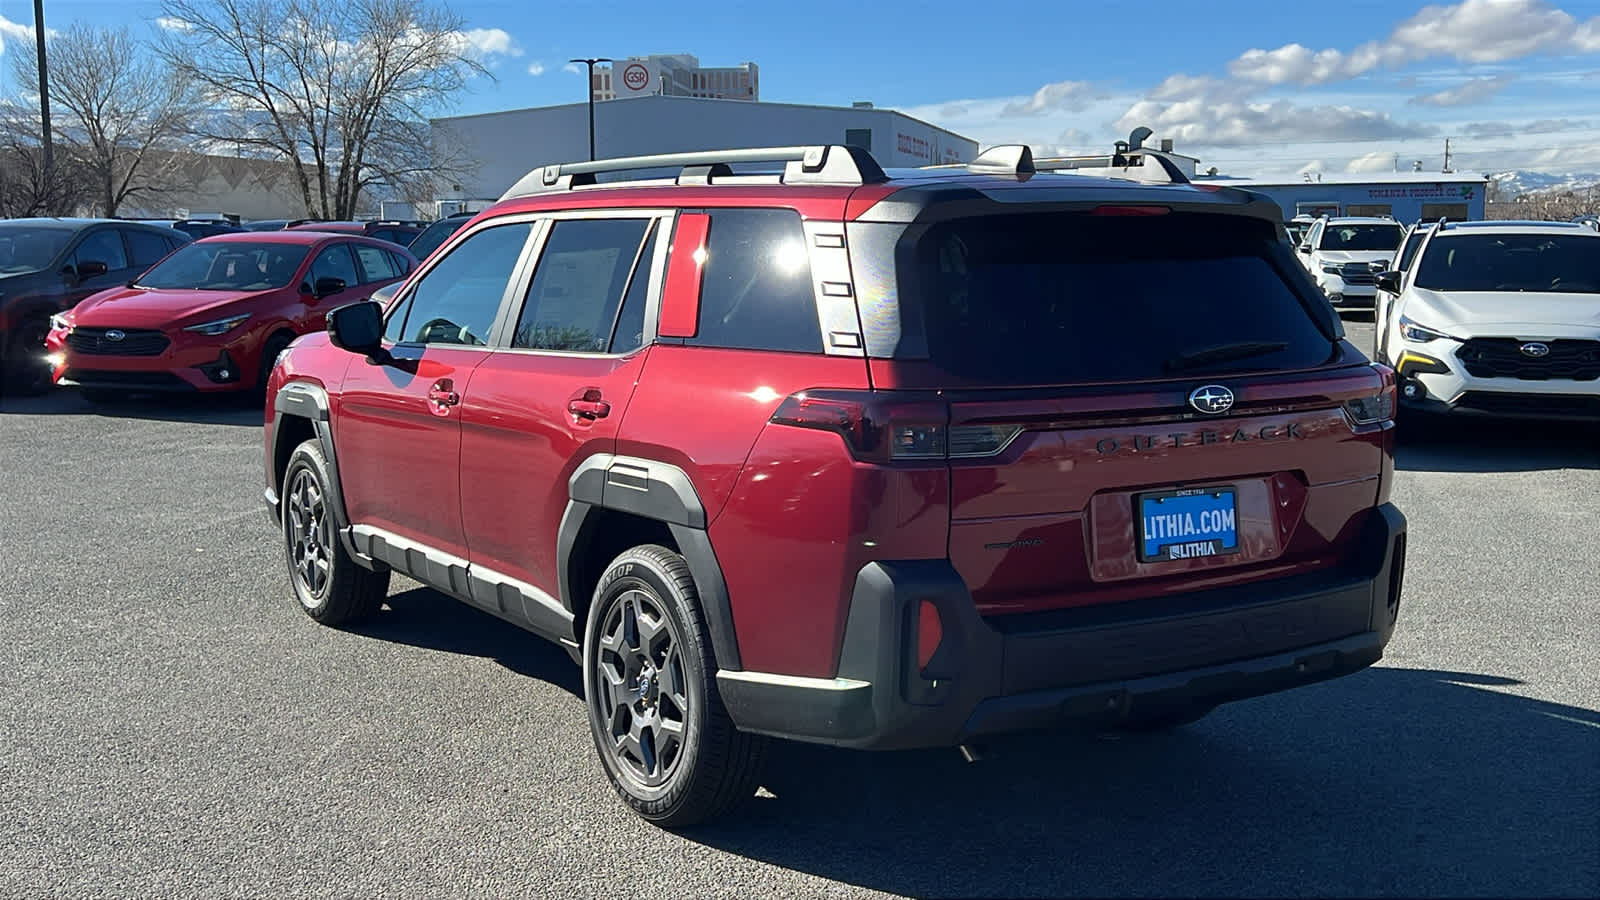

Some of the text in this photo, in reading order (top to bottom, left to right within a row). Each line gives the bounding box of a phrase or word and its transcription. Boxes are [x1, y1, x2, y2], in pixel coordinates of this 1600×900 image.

[627, 71, 645, 83] GSR
[1096, 423, 1304, 454] OUTBACK
[1176, 489, 1192, 497] SINCE
[1143, 508, 1235, 541] LITHIA.COM
[1180, 541, 1216, 559] LITHIA
